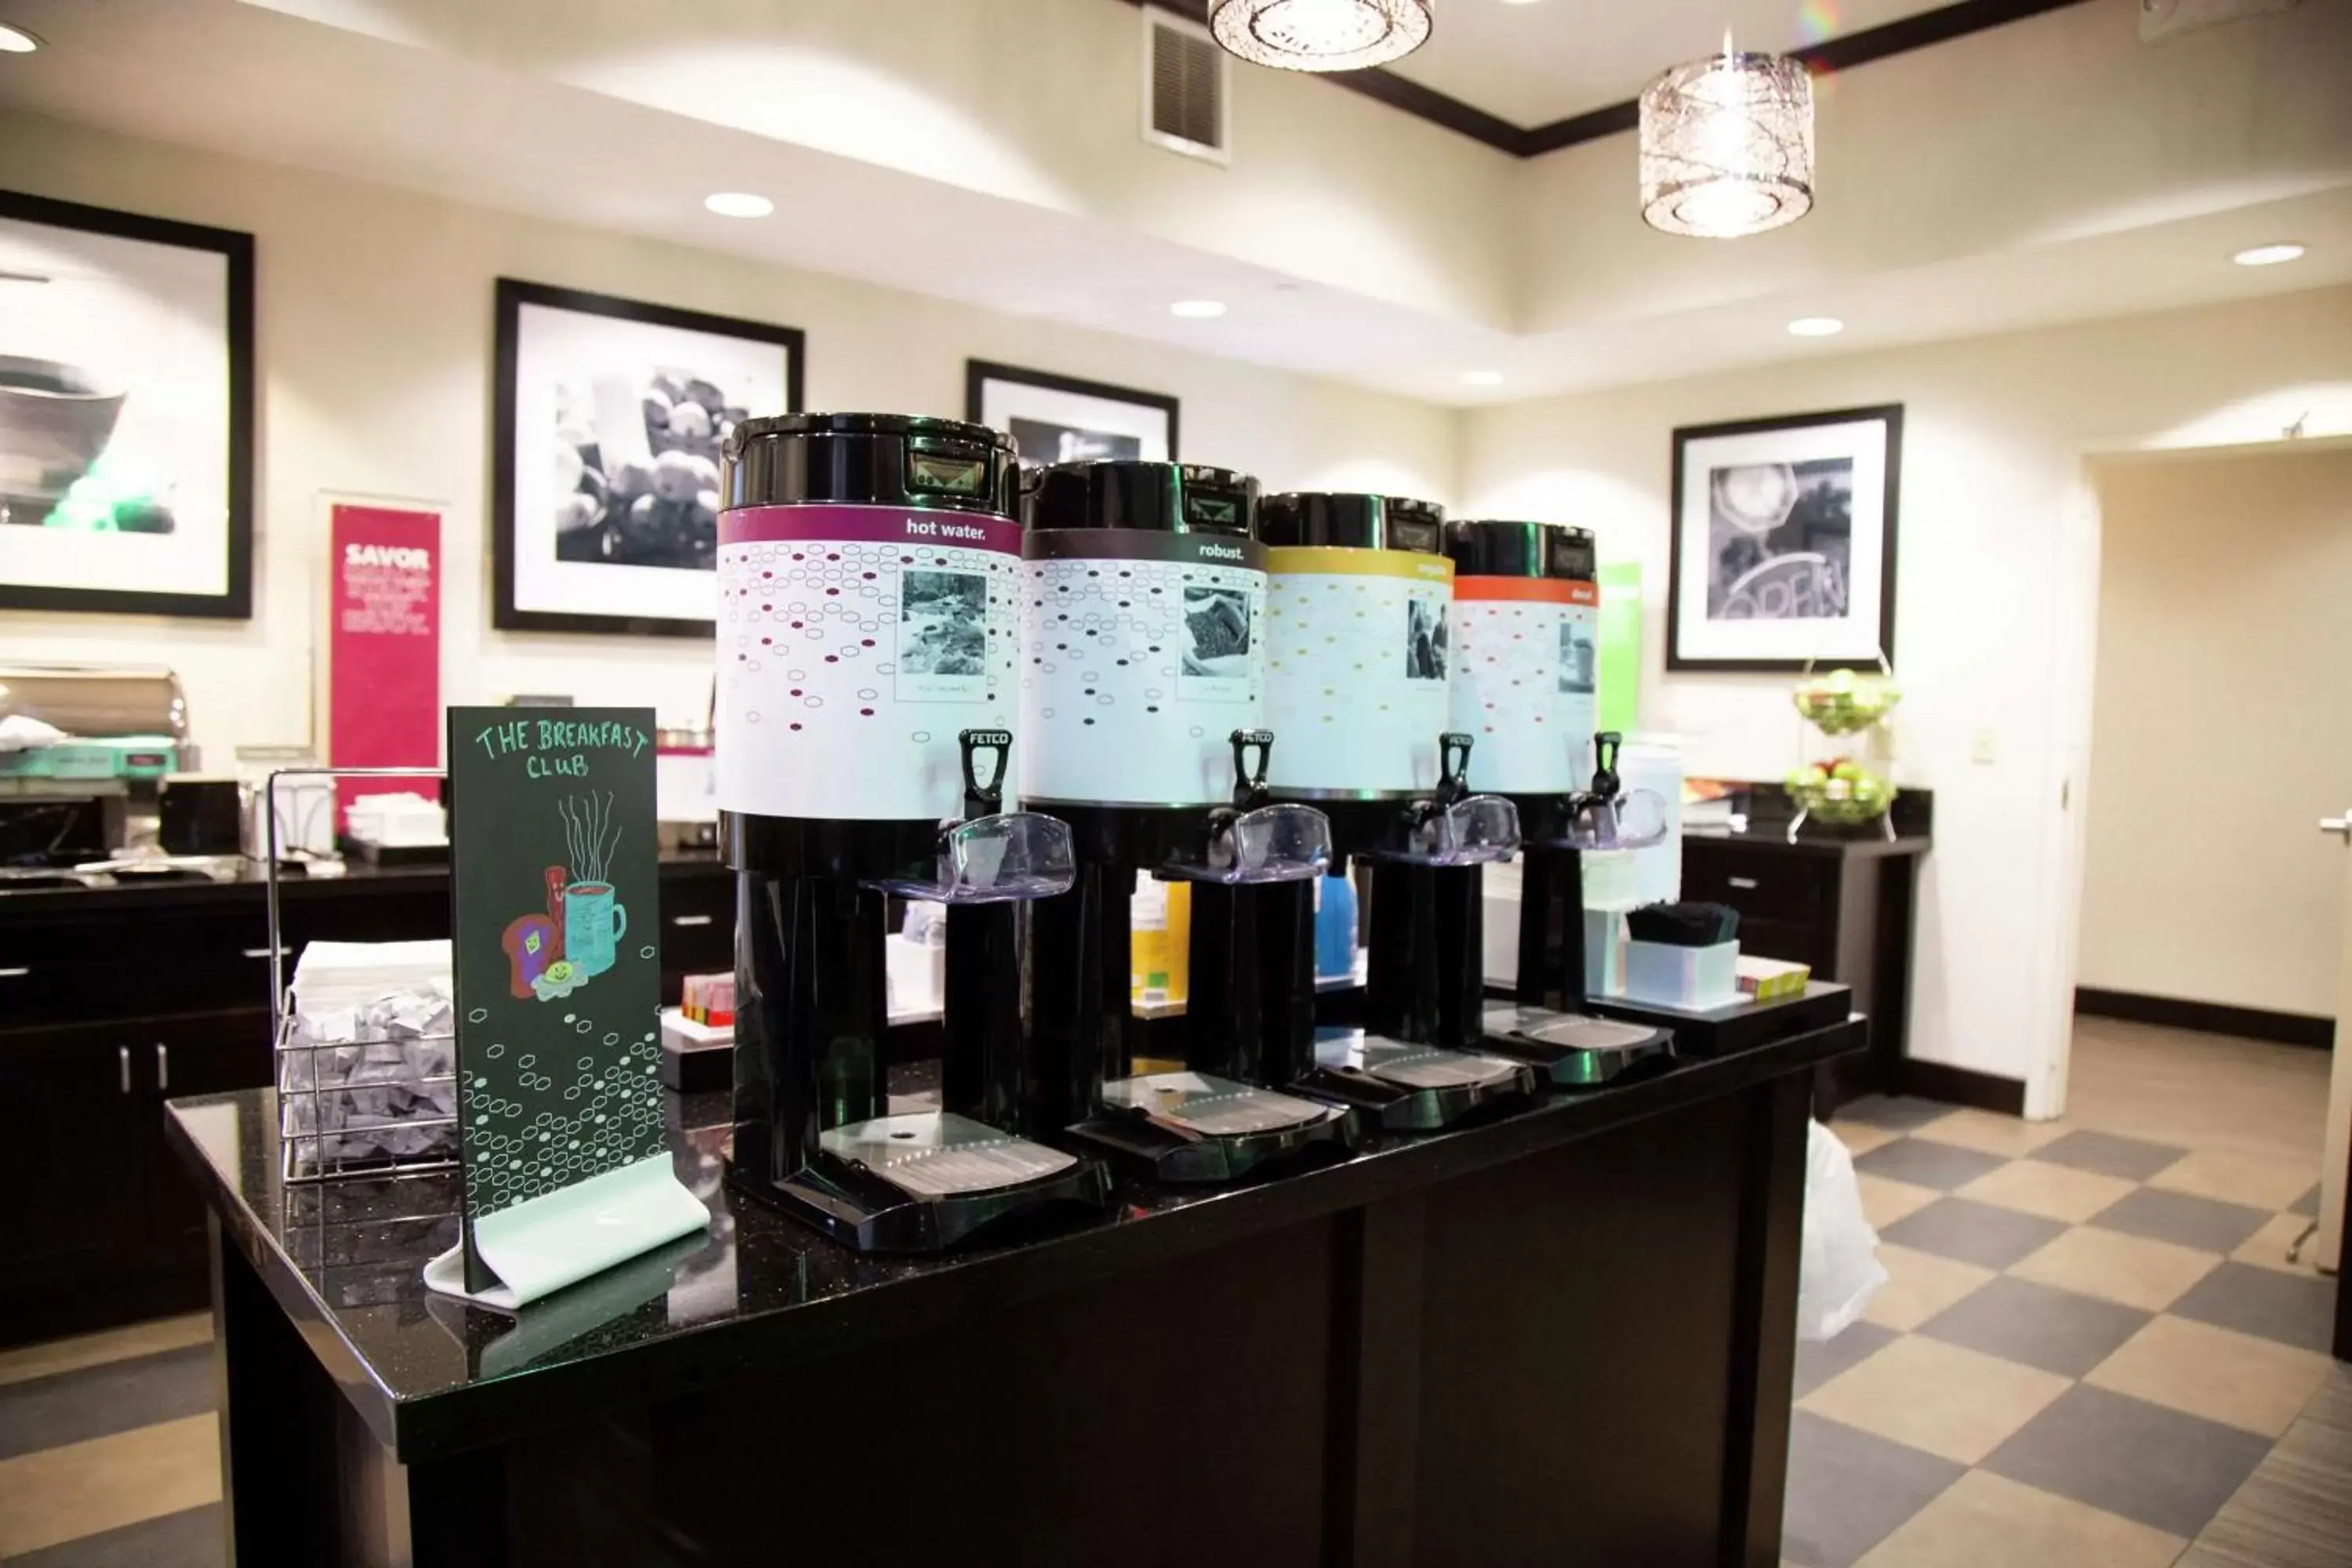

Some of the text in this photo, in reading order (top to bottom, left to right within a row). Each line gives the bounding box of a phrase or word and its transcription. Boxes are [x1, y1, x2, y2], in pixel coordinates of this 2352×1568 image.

[906, 518, 985, 539] hot water.
[345, 544, 429, 569] SAVOR
[1200, 543, 1244, 560] robust.
[476, 720, 648, 760] THE BREAKFAST
[970, 733, 1008, 744] FETCO
[527, 754, 589, 779] CLUB
